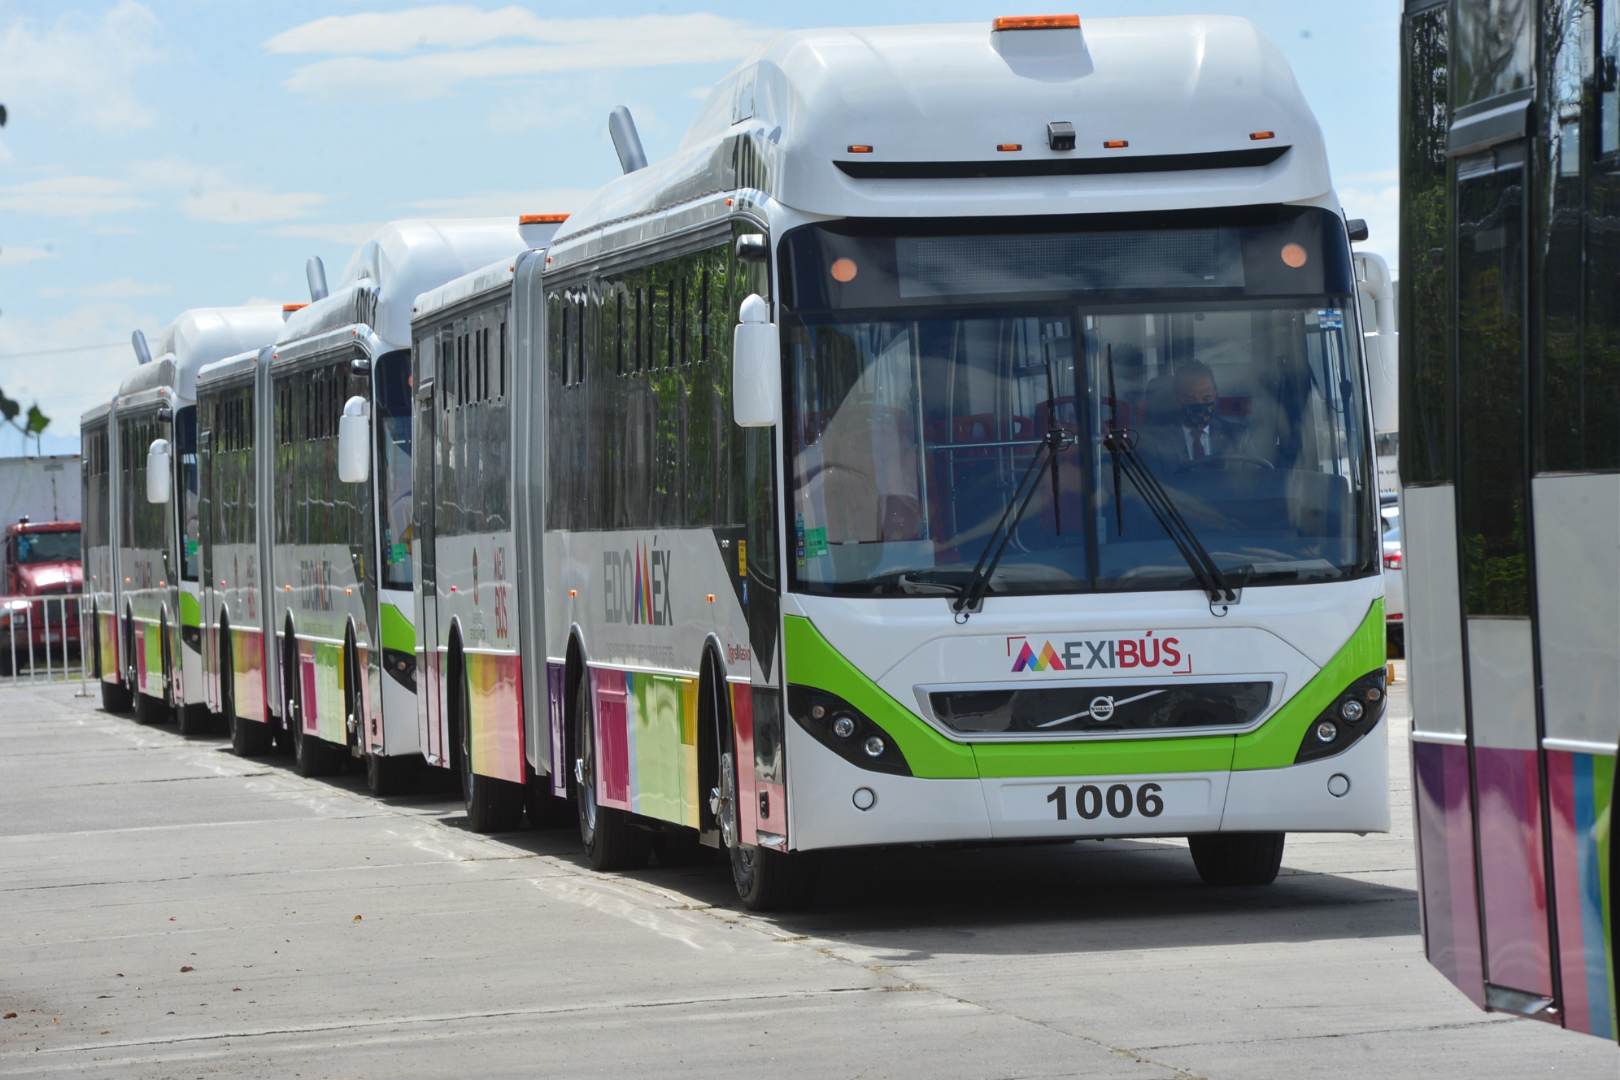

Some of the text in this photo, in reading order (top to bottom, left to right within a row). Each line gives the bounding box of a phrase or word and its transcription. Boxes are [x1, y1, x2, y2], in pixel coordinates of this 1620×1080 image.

[603, 535, 673, 626] EDOMÉX
[1011, 631, 1181, 672] MEXIBÚS
[1047, 783, 1164, 820] 1006
